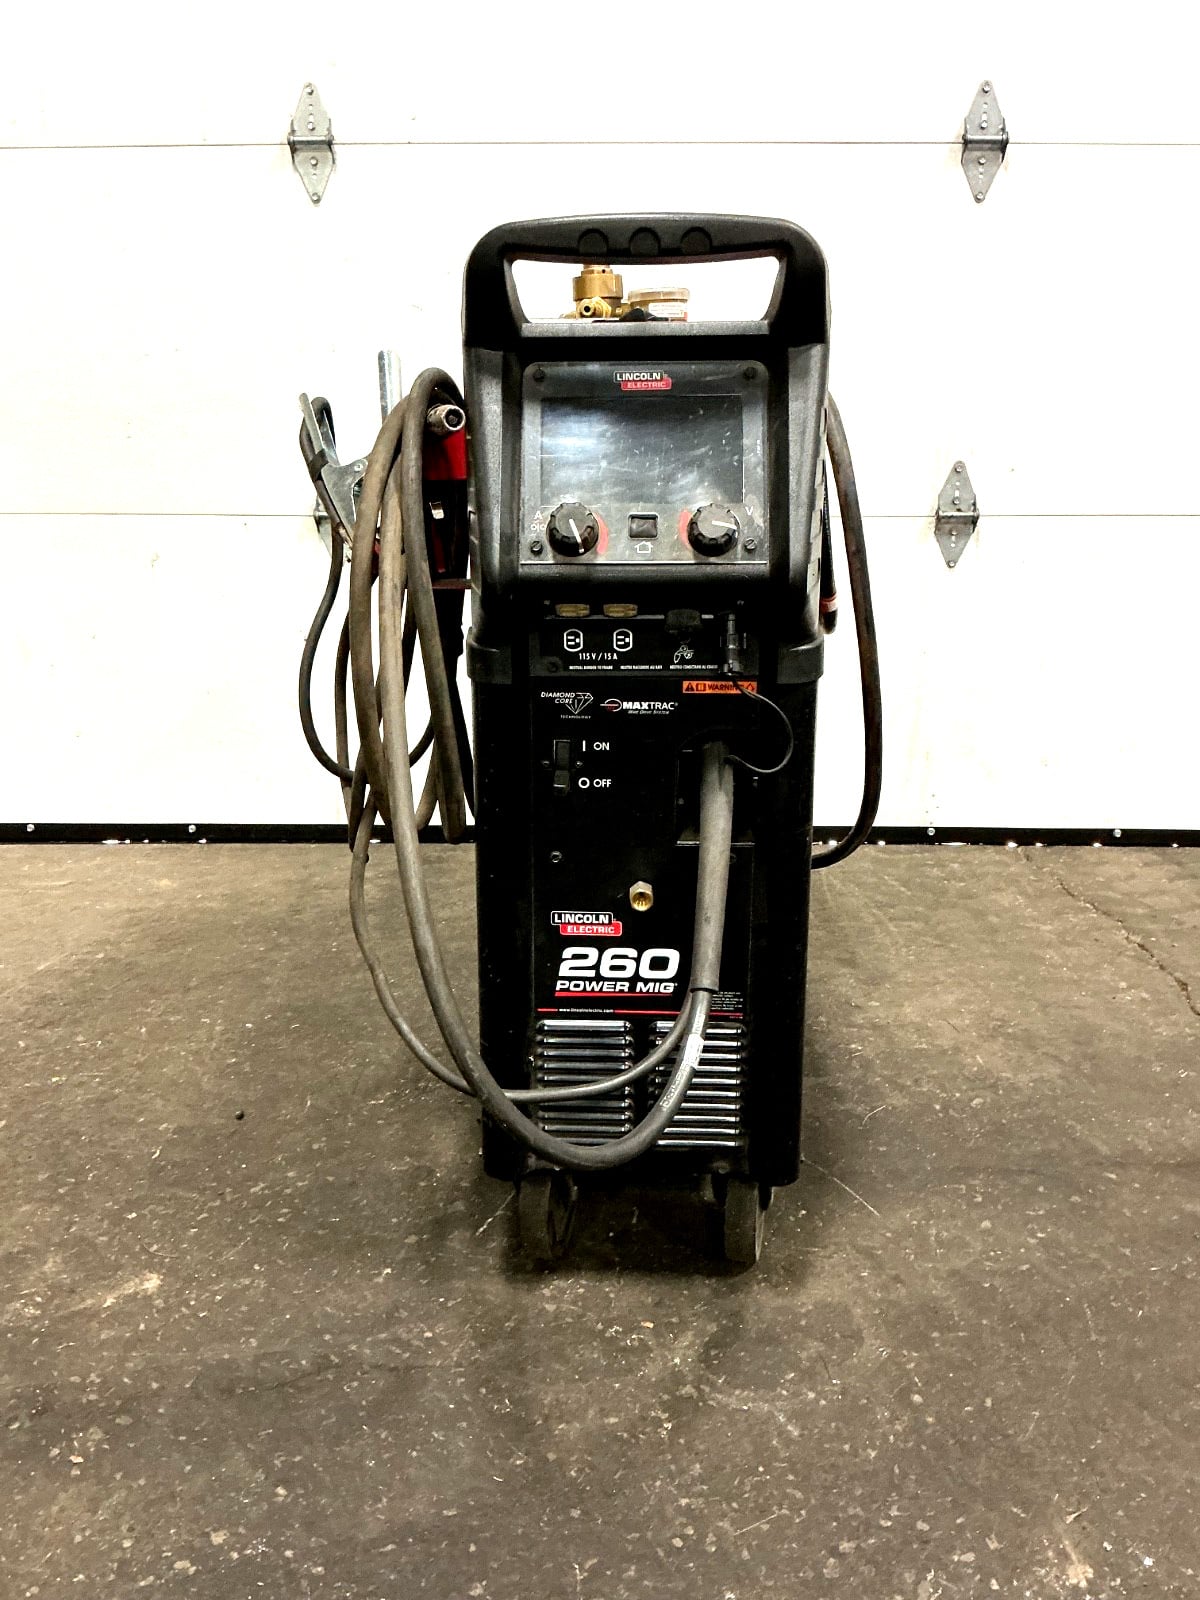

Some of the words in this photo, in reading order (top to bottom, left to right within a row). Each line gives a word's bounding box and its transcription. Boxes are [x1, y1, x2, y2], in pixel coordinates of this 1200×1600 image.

[616, 372, 661, 381] LINCOLN
[593, 741, 610, 751] ON
[593, 778, 612, 788] OFF
[554, 913, 610, 924] LINCOLN
[567, 925, 615, 934] ELECTRIC
[558, 946, 680, 979] 260
[555, 980, 630, 992] POWER
